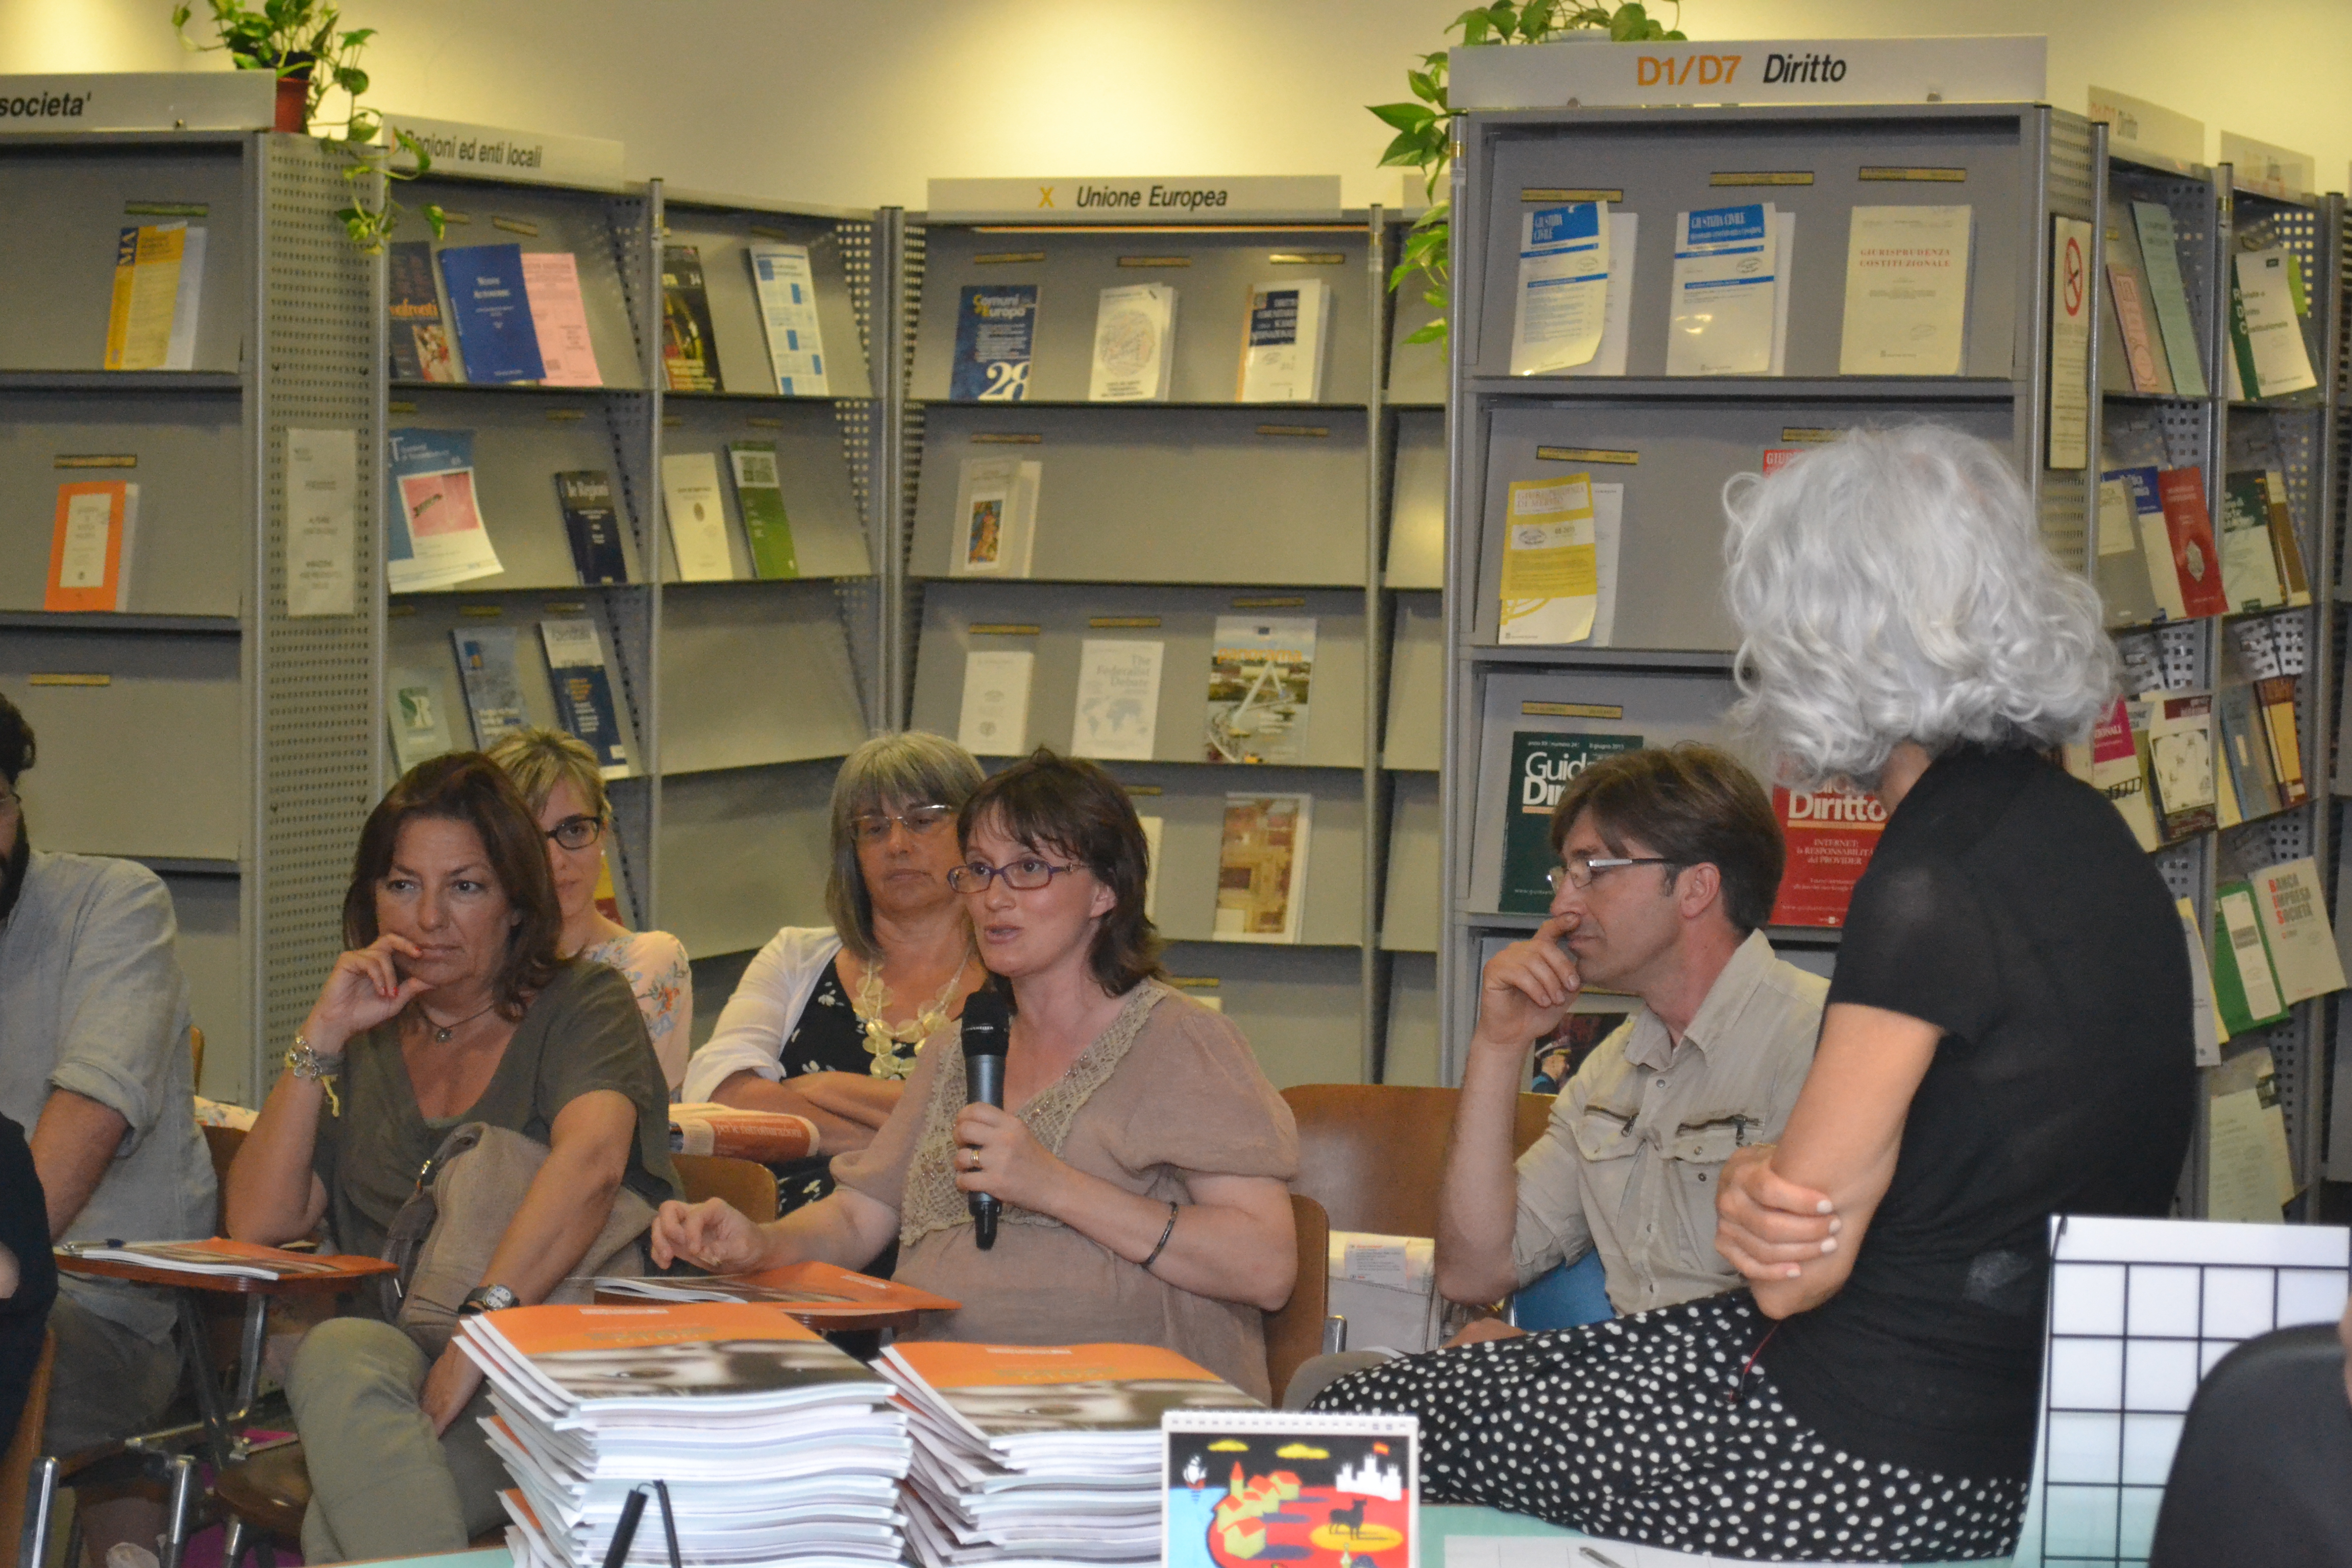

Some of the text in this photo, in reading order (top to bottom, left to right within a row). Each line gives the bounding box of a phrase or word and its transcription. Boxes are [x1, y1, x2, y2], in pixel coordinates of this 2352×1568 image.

[1637, 54, 1847, 86] D1/D7 Diritto
[0, 90, 91, 117] societa'
[460, 137, 477, 160] ed
[479, 141, 505, 164] enti
[507, 141, 542, 168] locali
[1040, 185, 1228, 212] X Unione Europea
[1217, 647, 1303, 664] panorama
[1526, 751, 1588, 781] Guid
[1788, 789, 1888, 821] Diritto
